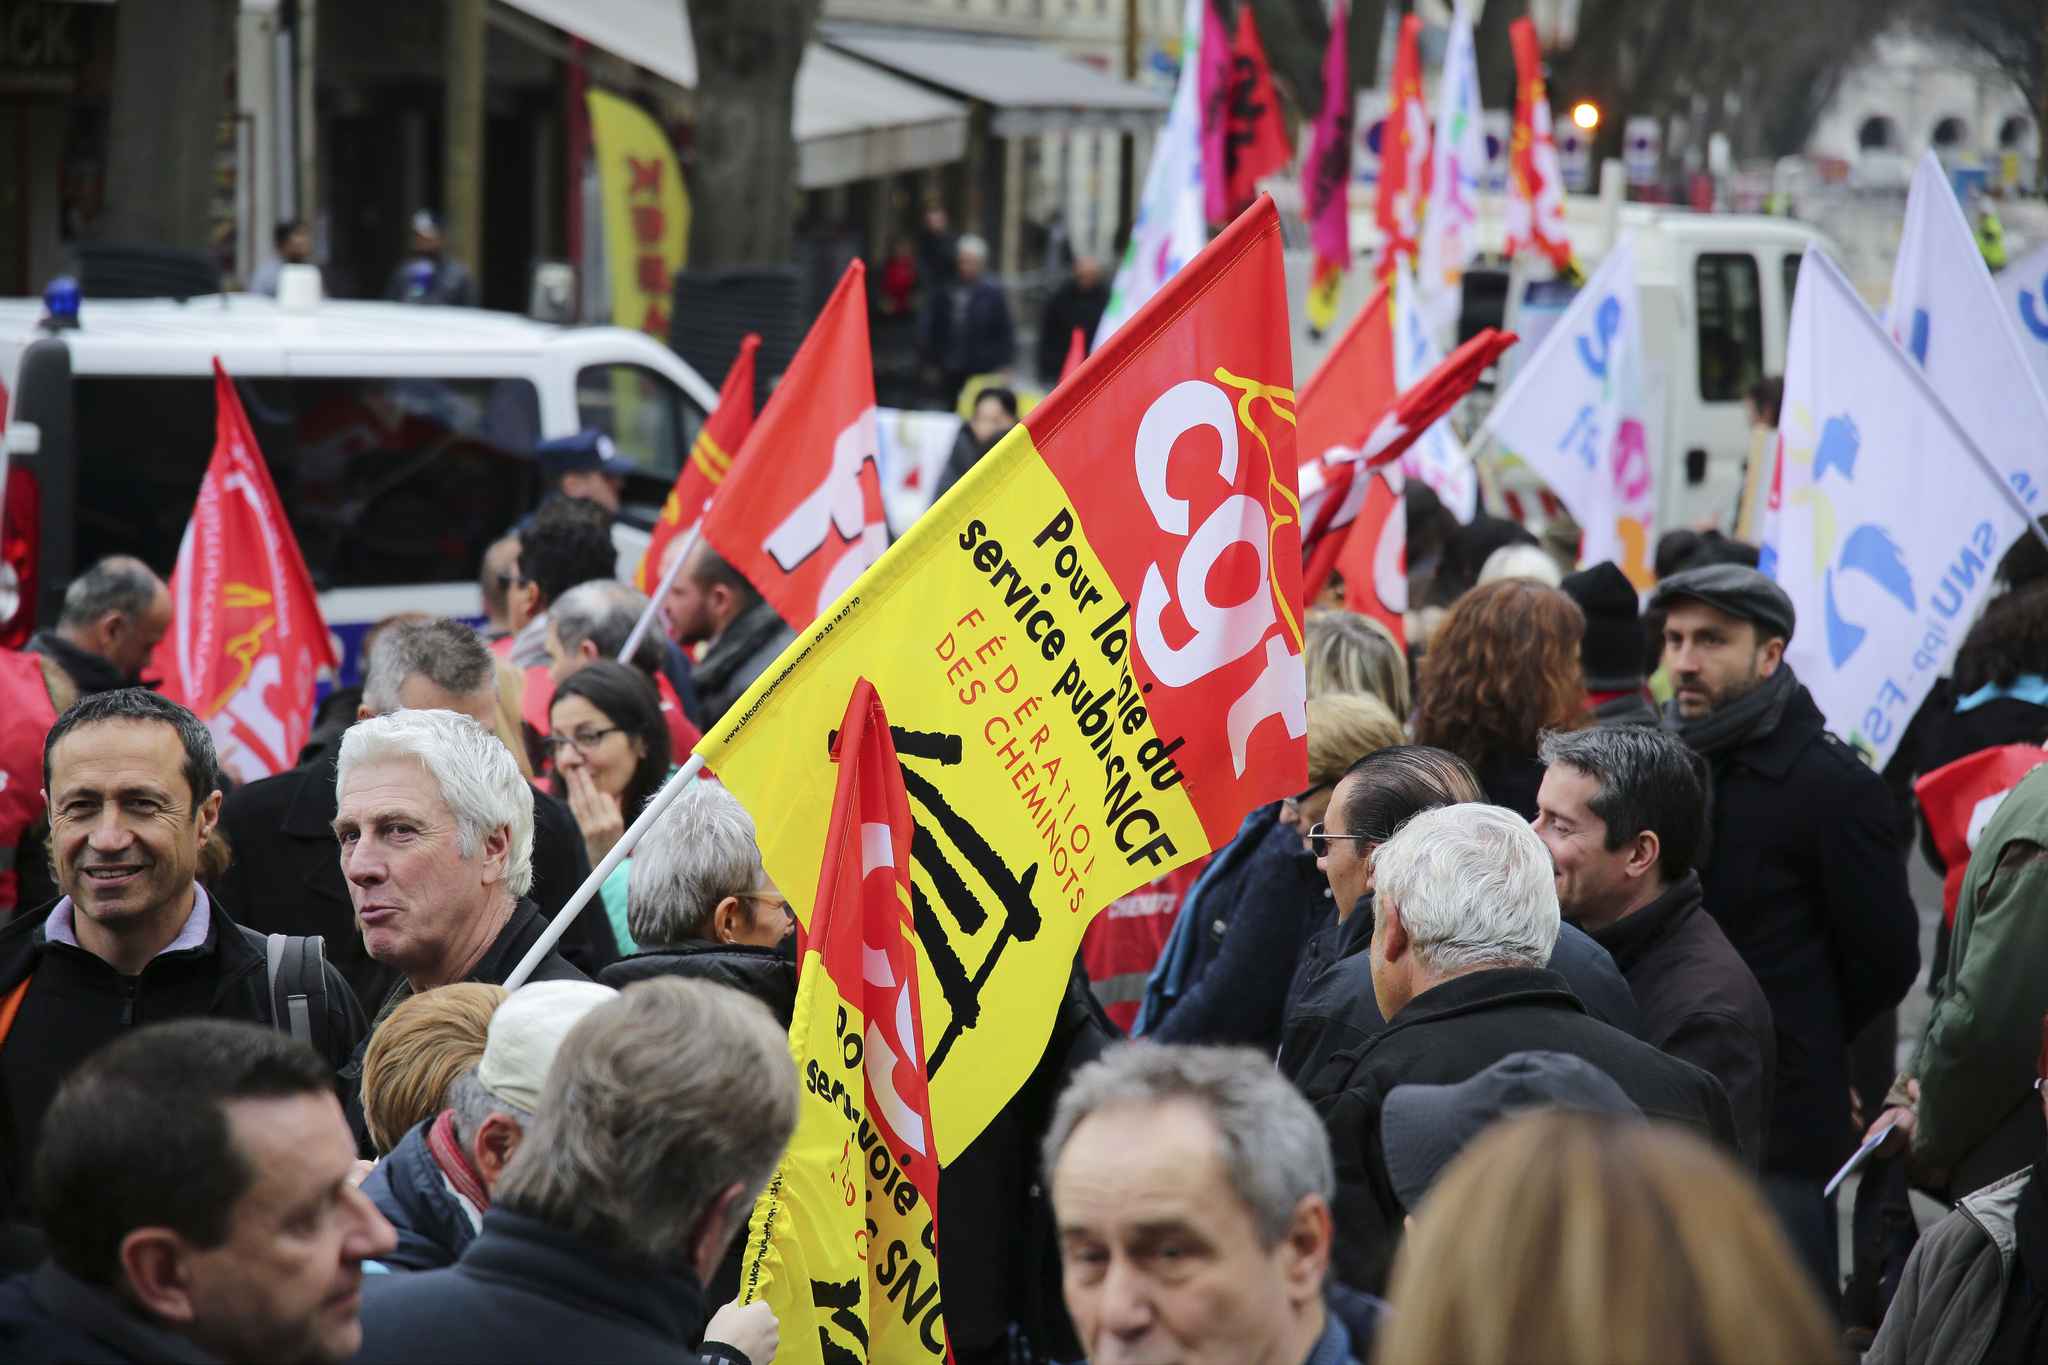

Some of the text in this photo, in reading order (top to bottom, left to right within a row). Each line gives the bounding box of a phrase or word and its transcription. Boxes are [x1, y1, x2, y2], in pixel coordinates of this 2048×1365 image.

[723, 647, 812, 744] www.LMcommunication.com
[957, 608, 1095, 875] FÉDÉRATIO
[959, 519, 1066, 661] service
[1051, 658, 1116, 761] publi
[1032, 507, 1186, 791] Pour la oie du
[936, 632, 1085, 913] DES CHEMINOTS
[876, 1239, 945, 1356] SNC
